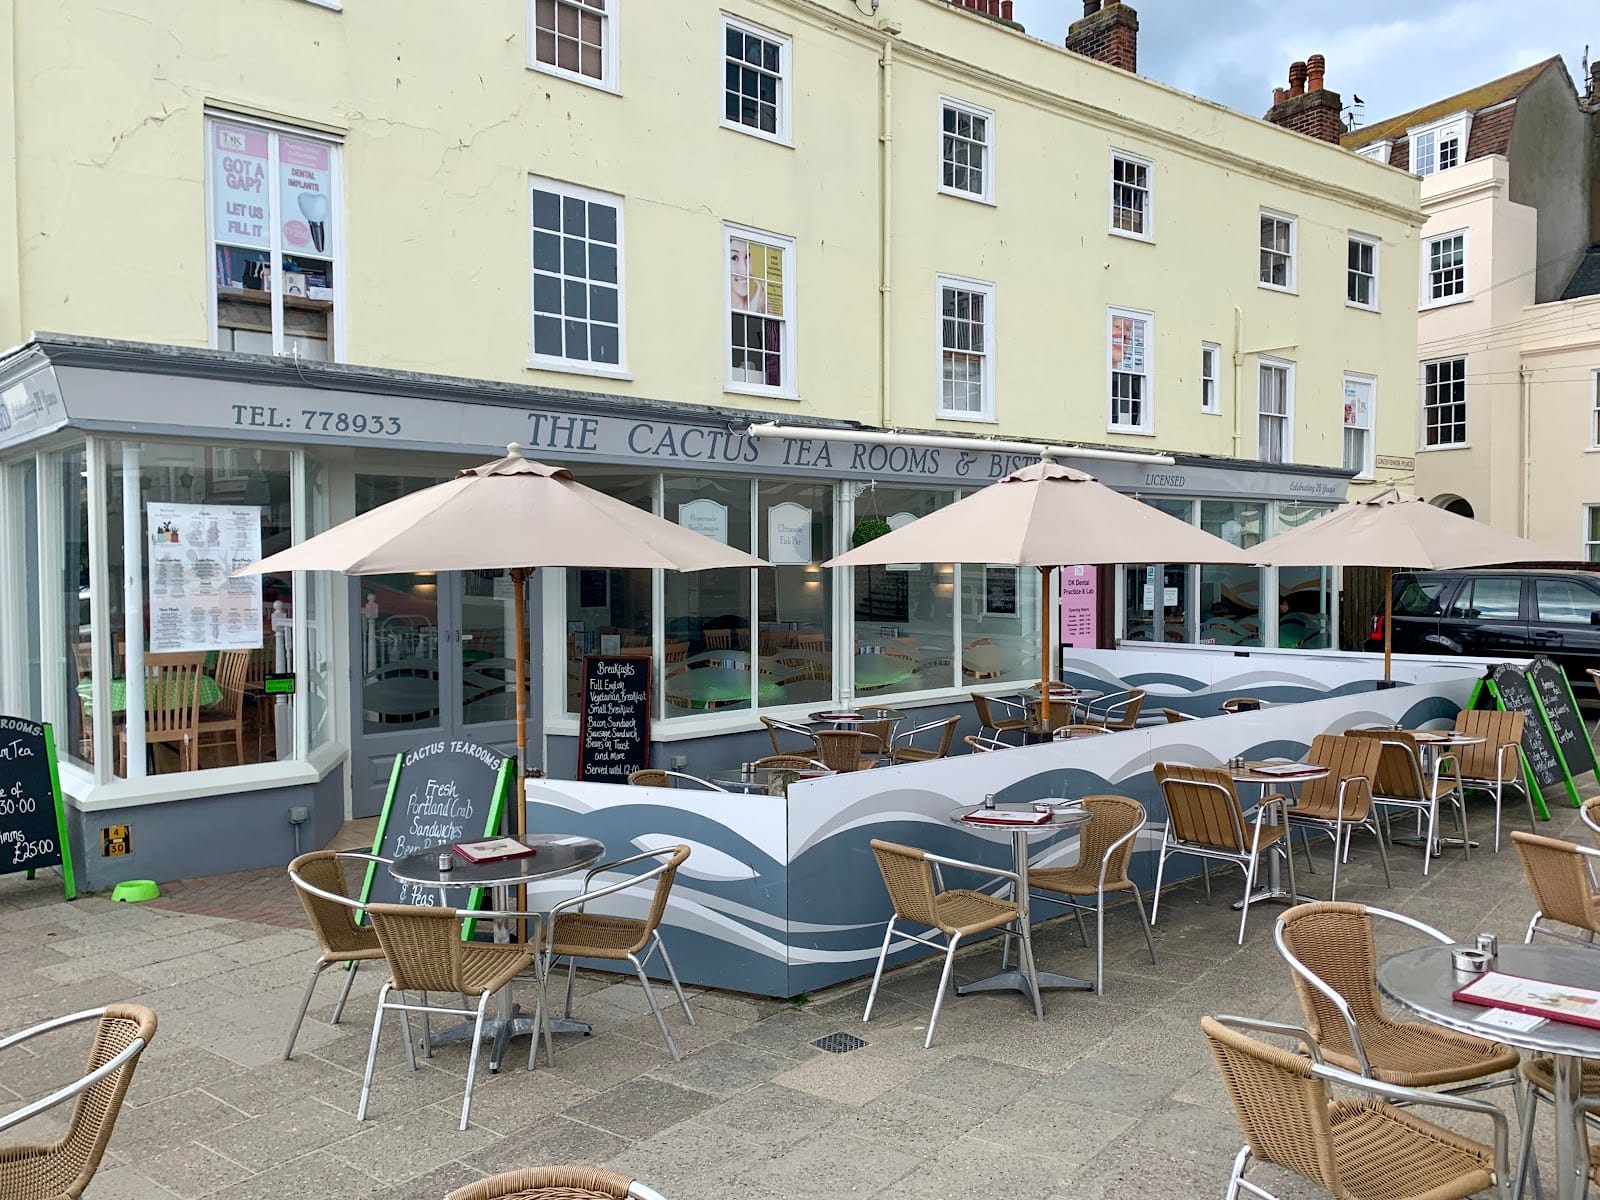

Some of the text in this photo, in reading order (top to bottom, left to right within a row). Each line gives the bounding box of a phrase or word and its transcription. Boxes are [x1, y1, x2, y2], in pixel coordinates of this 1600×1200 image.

[222, 156, 264, 180] GOT A
[291, 168, 316, 180] DENTAL
[226, 173, 262, 194] GAP?
[288, 178, 319, 191] IMPLANTS
[226, 201, 264, 220] LET US
[228, 220, 262, 238] FILL IT
[232, 405, 402, 435] TEL: 778933
[528, 413, 1058, 478] THE CACTUS TEA ROOMS & BIST
[1145, 473, 1186, 487] LICENSED
[597, 661, 635, 679] Breakfasts
[590, 679, 626, 694] Full English
[590, 690, 647, 705] Vegetarian Breakfast
[588, 702, 634, 716] Small Breakfast
[587, 715, 637, 730] Bacon Sandwich
[587, 727, 640, 742] Sausage Sandwich
[8, 738, 35, 759] Tea
[586, 737, 630, 751] Beans on Toast
[405, 741, 501, 771] CACTUS TEAROOMS
[595, 751, 609, 760] and
[585, 763, 609, 775] Served
[609, 764, 623, 775] until
[10, 781, 23, 798] of
[425, 779, 459, 798] Fresh
[407, 793, 473, 819] Portland Crab
[113, 828, 119, 837] 4
[409, 815, 463, 840] Sandwiches
[110, 844, 124, 854] 30
[411, 884, 434, 907] Peas
